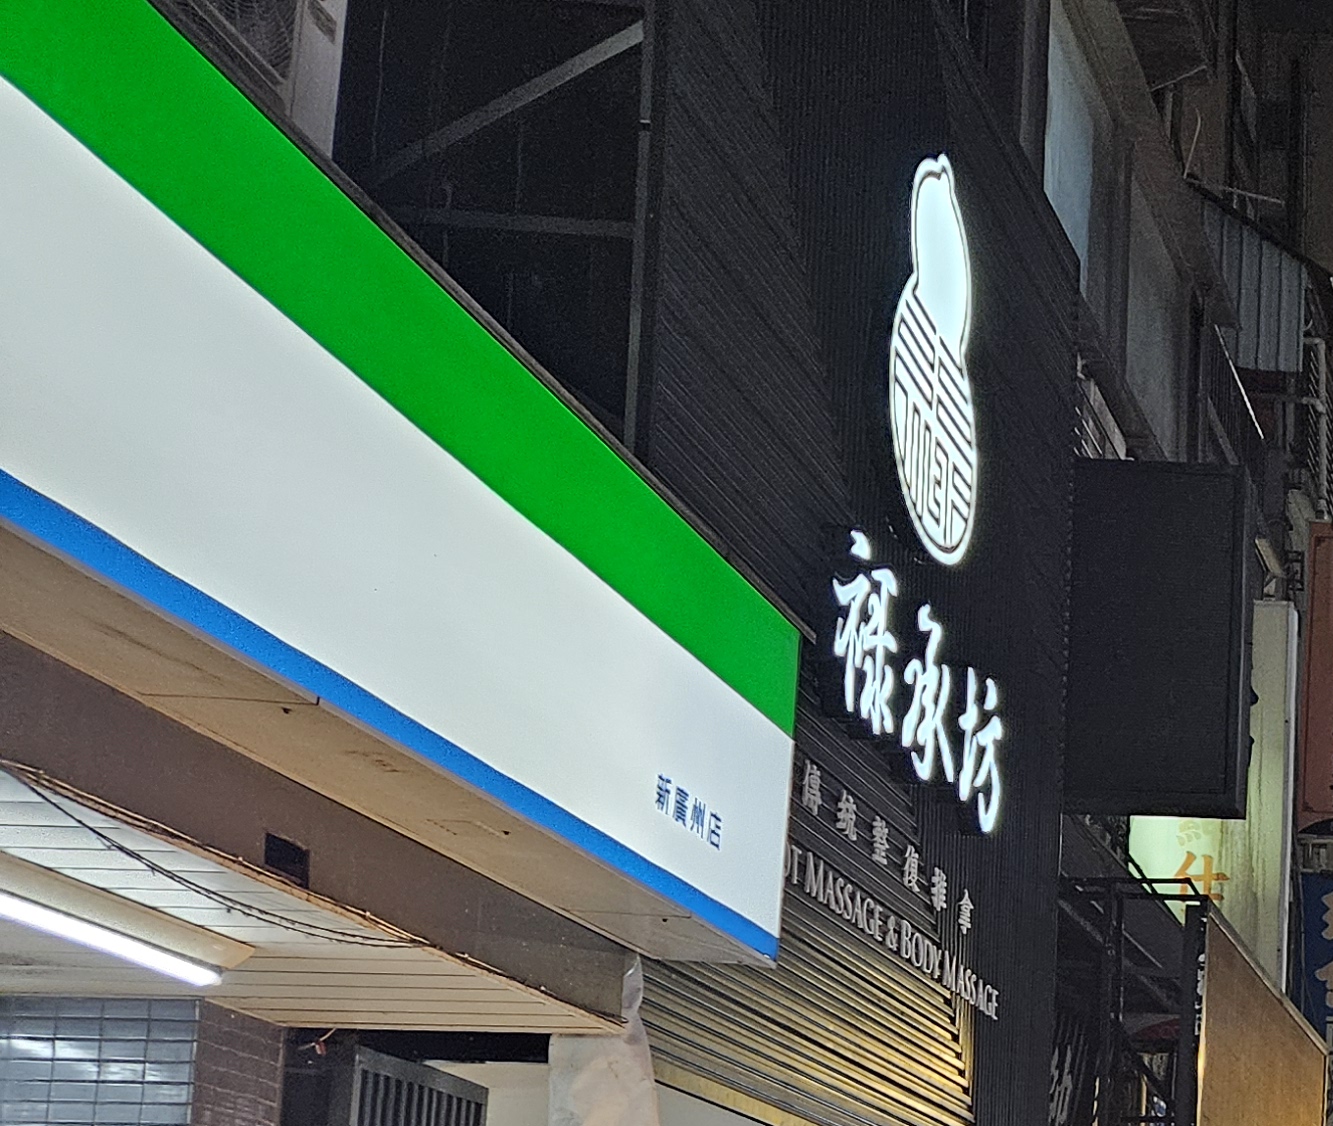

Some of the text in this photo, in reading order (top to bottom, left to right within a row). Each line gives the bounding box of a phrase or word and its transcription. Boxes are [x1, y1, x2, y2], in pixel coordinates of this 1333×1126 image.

[656, 773, 723, 851] 新廣州店
[804, 859, 884, 943] MASSAGE
[885, 917, 898, 947] &
[901, 921, 943, 980] BODY
[942, 953, 998, 1020] MASSAGE
